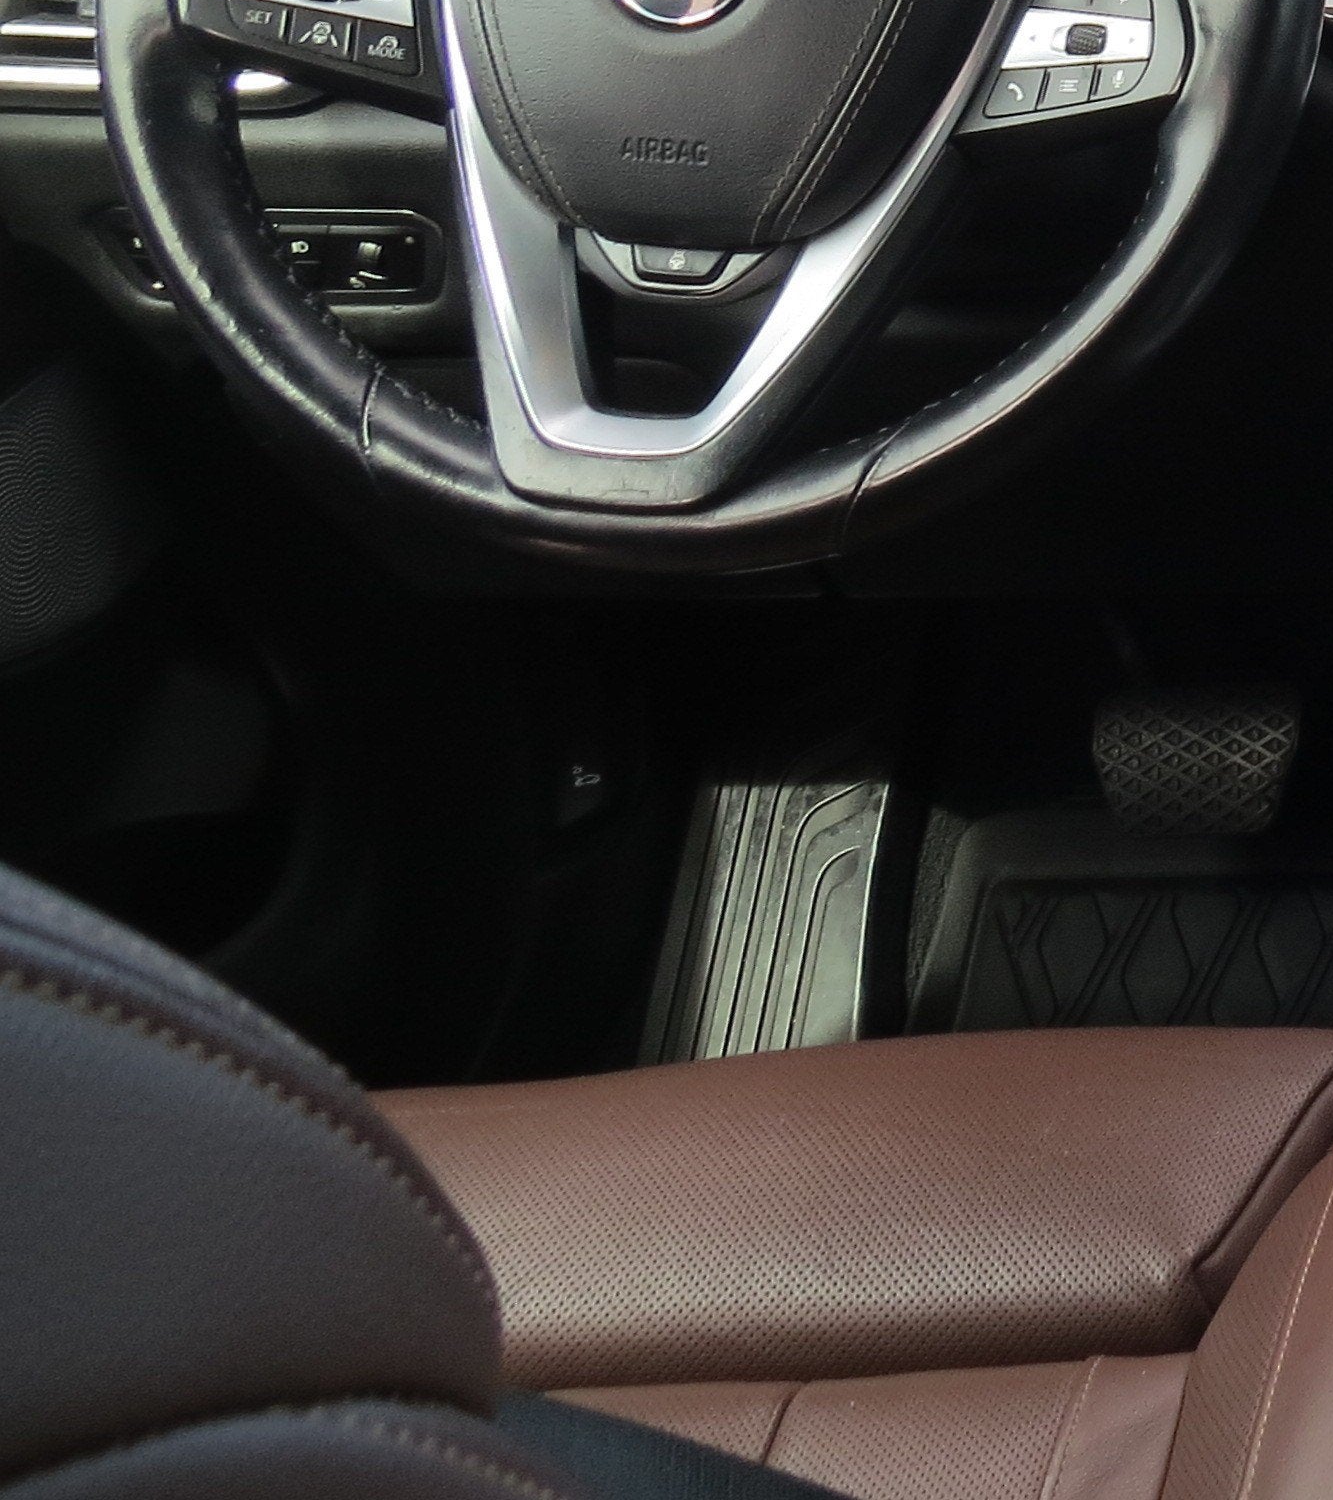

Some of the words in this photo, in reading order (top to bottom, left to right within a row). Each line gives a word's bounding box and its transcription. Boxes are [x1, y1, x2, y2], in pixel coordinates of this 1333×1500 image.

[244, 8, 274, 25] SET
[367, 43, 407, 61] MODE
[619, 136, 711, 168] AIRBAG
